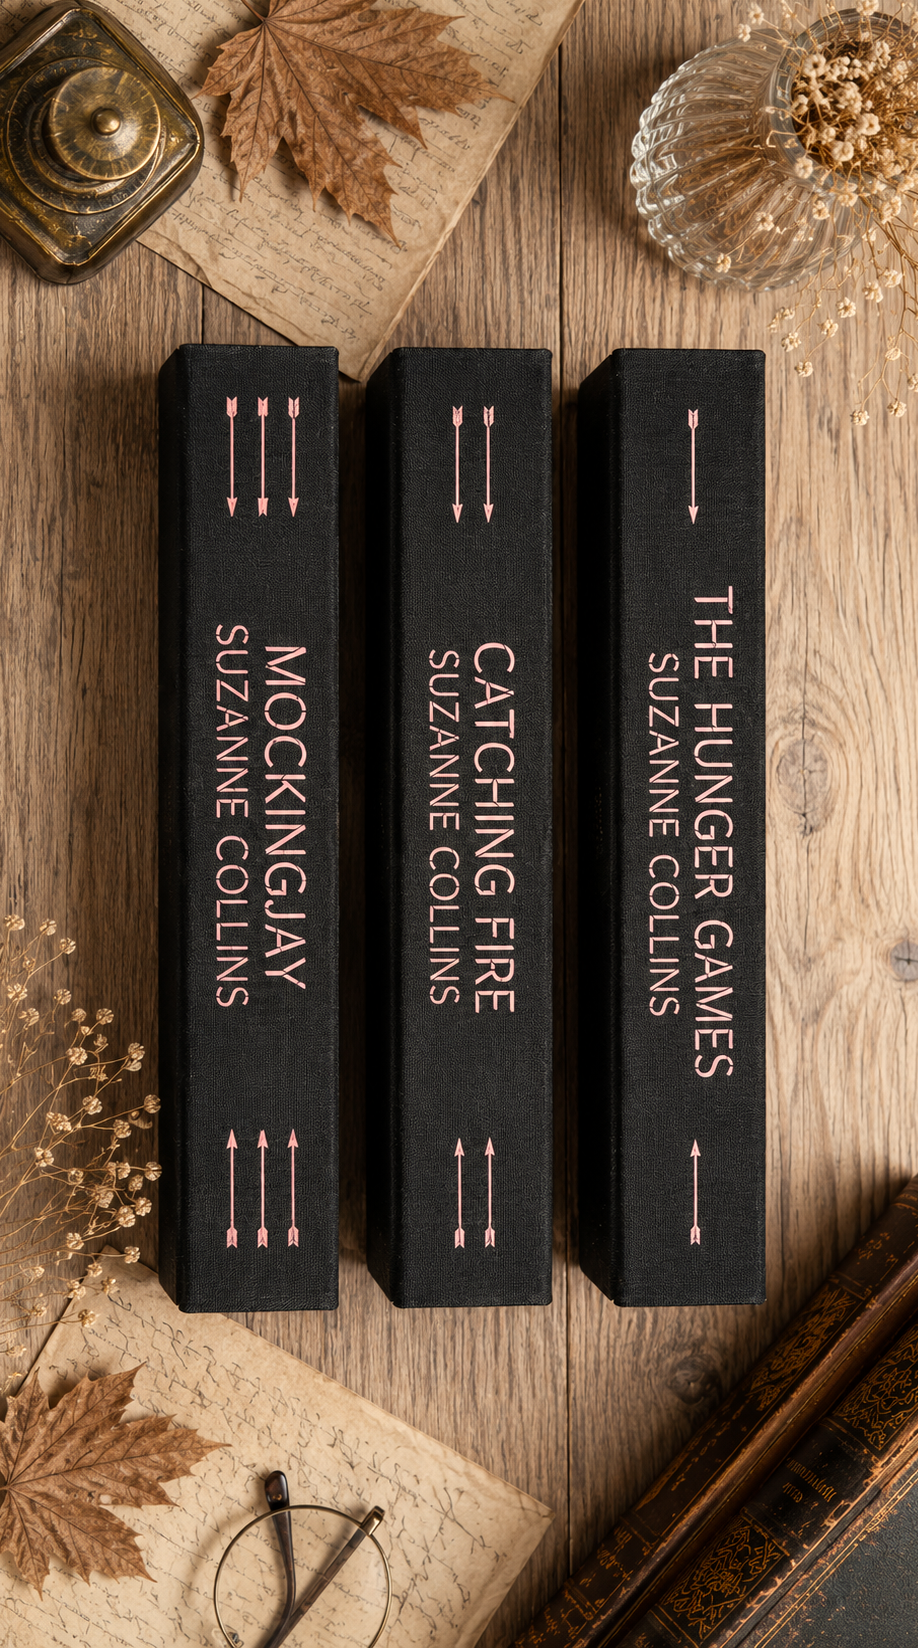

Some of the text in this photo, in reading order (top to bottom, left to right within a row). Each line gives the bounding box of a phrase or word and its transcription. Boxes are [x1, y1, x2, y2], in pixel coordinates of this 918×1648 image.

[215, 624, 250, 1008] SUZANNE COLLINS
[264, 646, 307, 990] MOCKINGJAY
[428, 649, 461, 1005] SUZANNE COLLINS
[473, 642, 516, 1014] CATCHING FIRE
[647, 652, 681, 1017] SUZANNE COLLINS
[693, 585, 734, 1078] THE HUNGER GAMES
